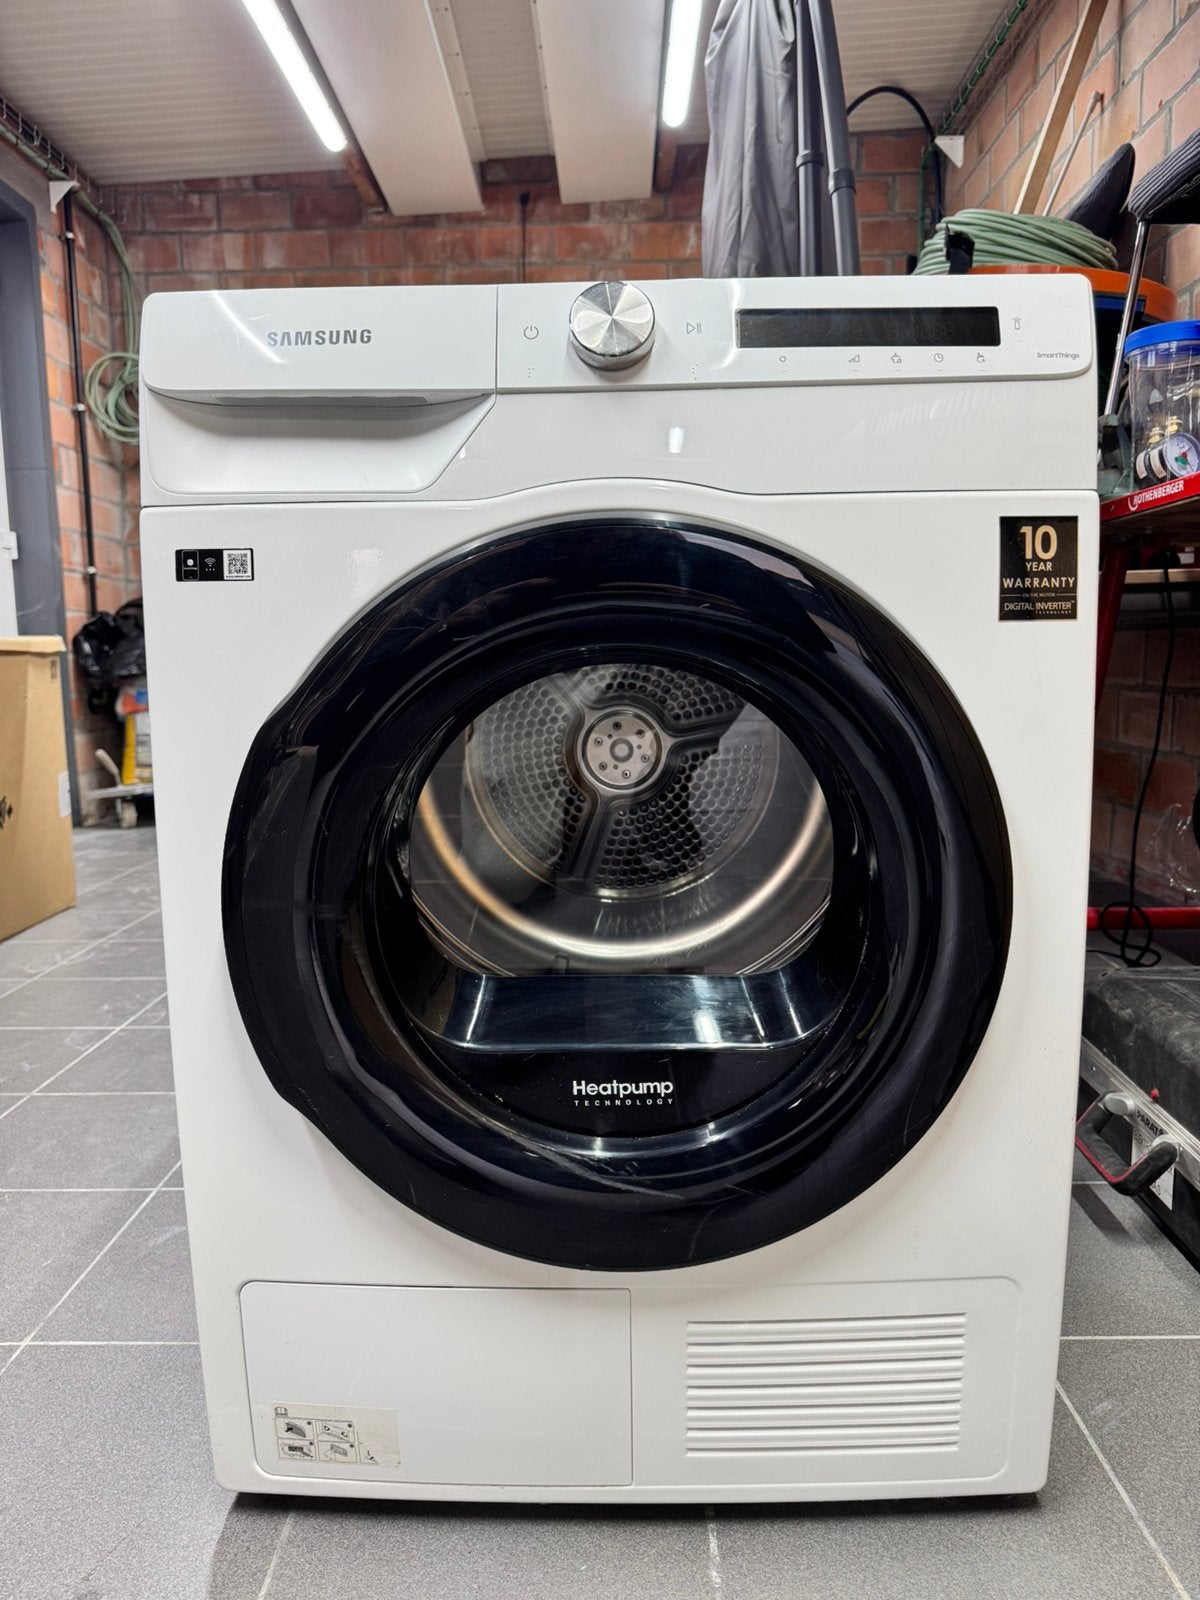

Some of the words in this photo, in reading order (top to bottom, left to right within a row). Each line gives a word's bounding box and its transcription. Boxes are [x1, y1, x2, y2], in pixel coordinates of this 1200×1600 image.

[266, 328, 373, 347] SAMSUNG
[1036, 352, 1080, 361] SmartThings
[1131, 479, 1185, 509] ROTHENBERGER
[1020, 525, 1058, 560] 10
[1025, 562, 1053, 572] YEAR
[1002, 577, 1075, 589] WARRANTY
[1004, 602, 1034, 610] DIGITAL
[1036, 601, 1072, 610] INVERTER
[572, 1080, 674, 1099] Heatpump
[574, 1098, 673, 1107] TECHNOLOGY
